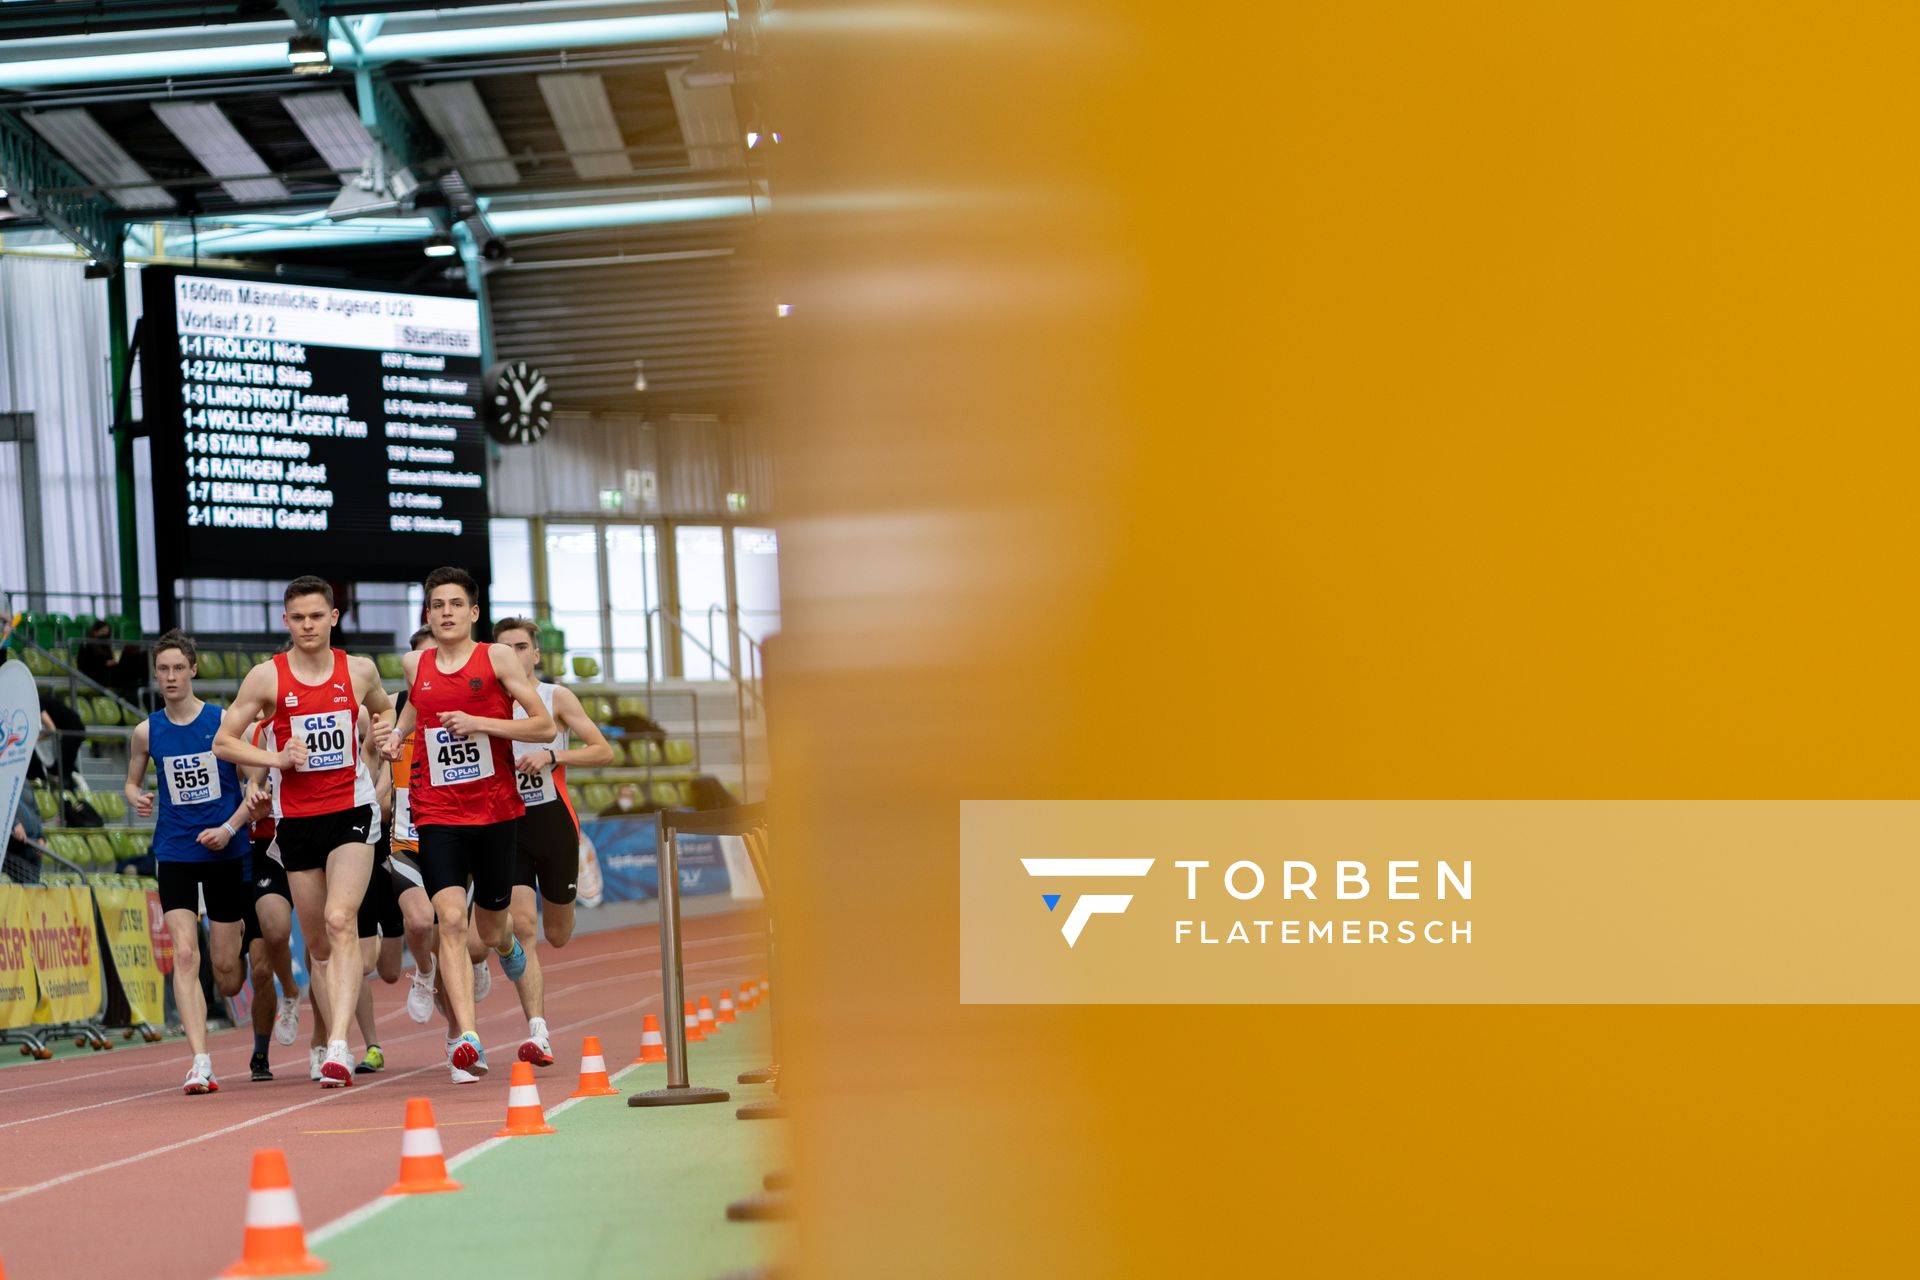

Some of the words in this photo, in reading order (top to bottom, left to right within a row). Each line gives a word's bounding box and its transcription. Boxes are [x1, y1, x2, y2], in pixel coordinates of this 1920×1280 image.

[181, 282, 233, 303] 1500m
[324, 294, 381, 317] Jugend
[181, 309, 239, 330] Vorlauf
[244, 314, 253, 331] 2
[267, 316, 276, 333] 2
[403, 326, 470, 348] Startliste
[179, 335, 201, 356] 1-1
[273, 341, 306, 364] Nick
[180, 359, 205, 380] 1-2
[276, 365, 313, 388] Silas
[182, 383, 206, 404] 1-3
[206, 384, 293, 409] LINDSTROT
[293, 390, 349, 414] Lennart
[183, 407, 207, 429] 1-4
[207, 409, 334, 436] WOLLSCHLÄGER
[335, 416, 368, 439] Finn
[185, 456, 210, 478] 1-6
[210, 457, 284, 482] RATHGEN
[186, 481, 211, 502] 1-7
[187, 505, 211, 527] 2-1
[275, 508, 328, 531] Gabriel
[305, 729, 345, 753] 400
[323, 755, 343, 764] PLAN
[437, 742, 480, 766] 455
[174, 768, 210, 789] 555
[457, 766, 479, 776] PLAN
[517, 771, 544, 790] 26
[190, 788, 208, 798] PLAN
